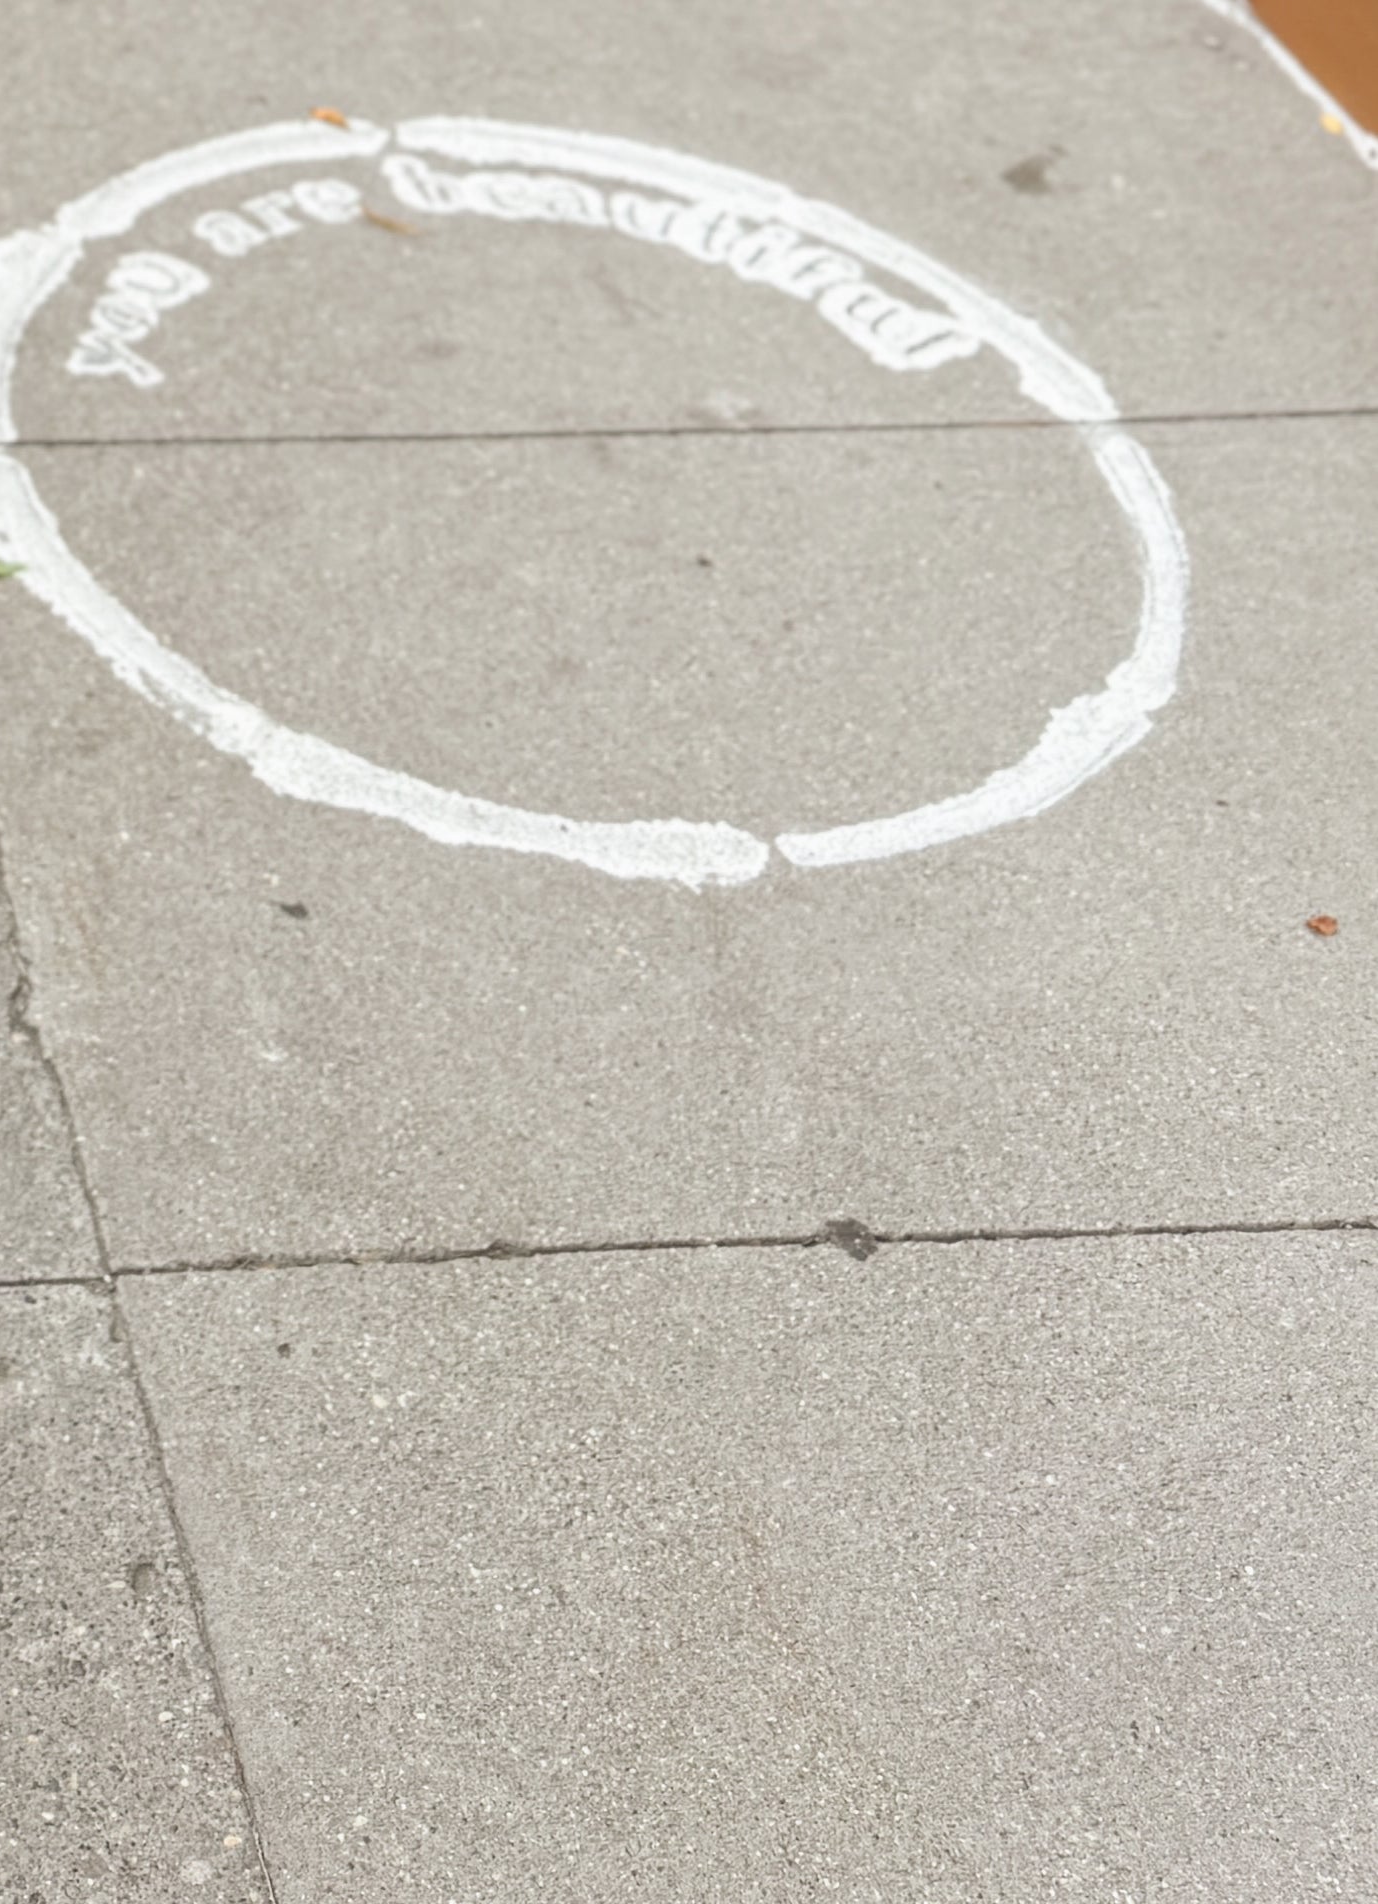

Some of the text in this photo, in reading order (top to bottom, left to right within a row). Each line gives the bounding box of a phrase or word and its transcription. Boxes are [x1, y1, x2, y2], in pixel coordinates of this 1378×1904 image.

[66, 155, 982, 388] you are beautiful
